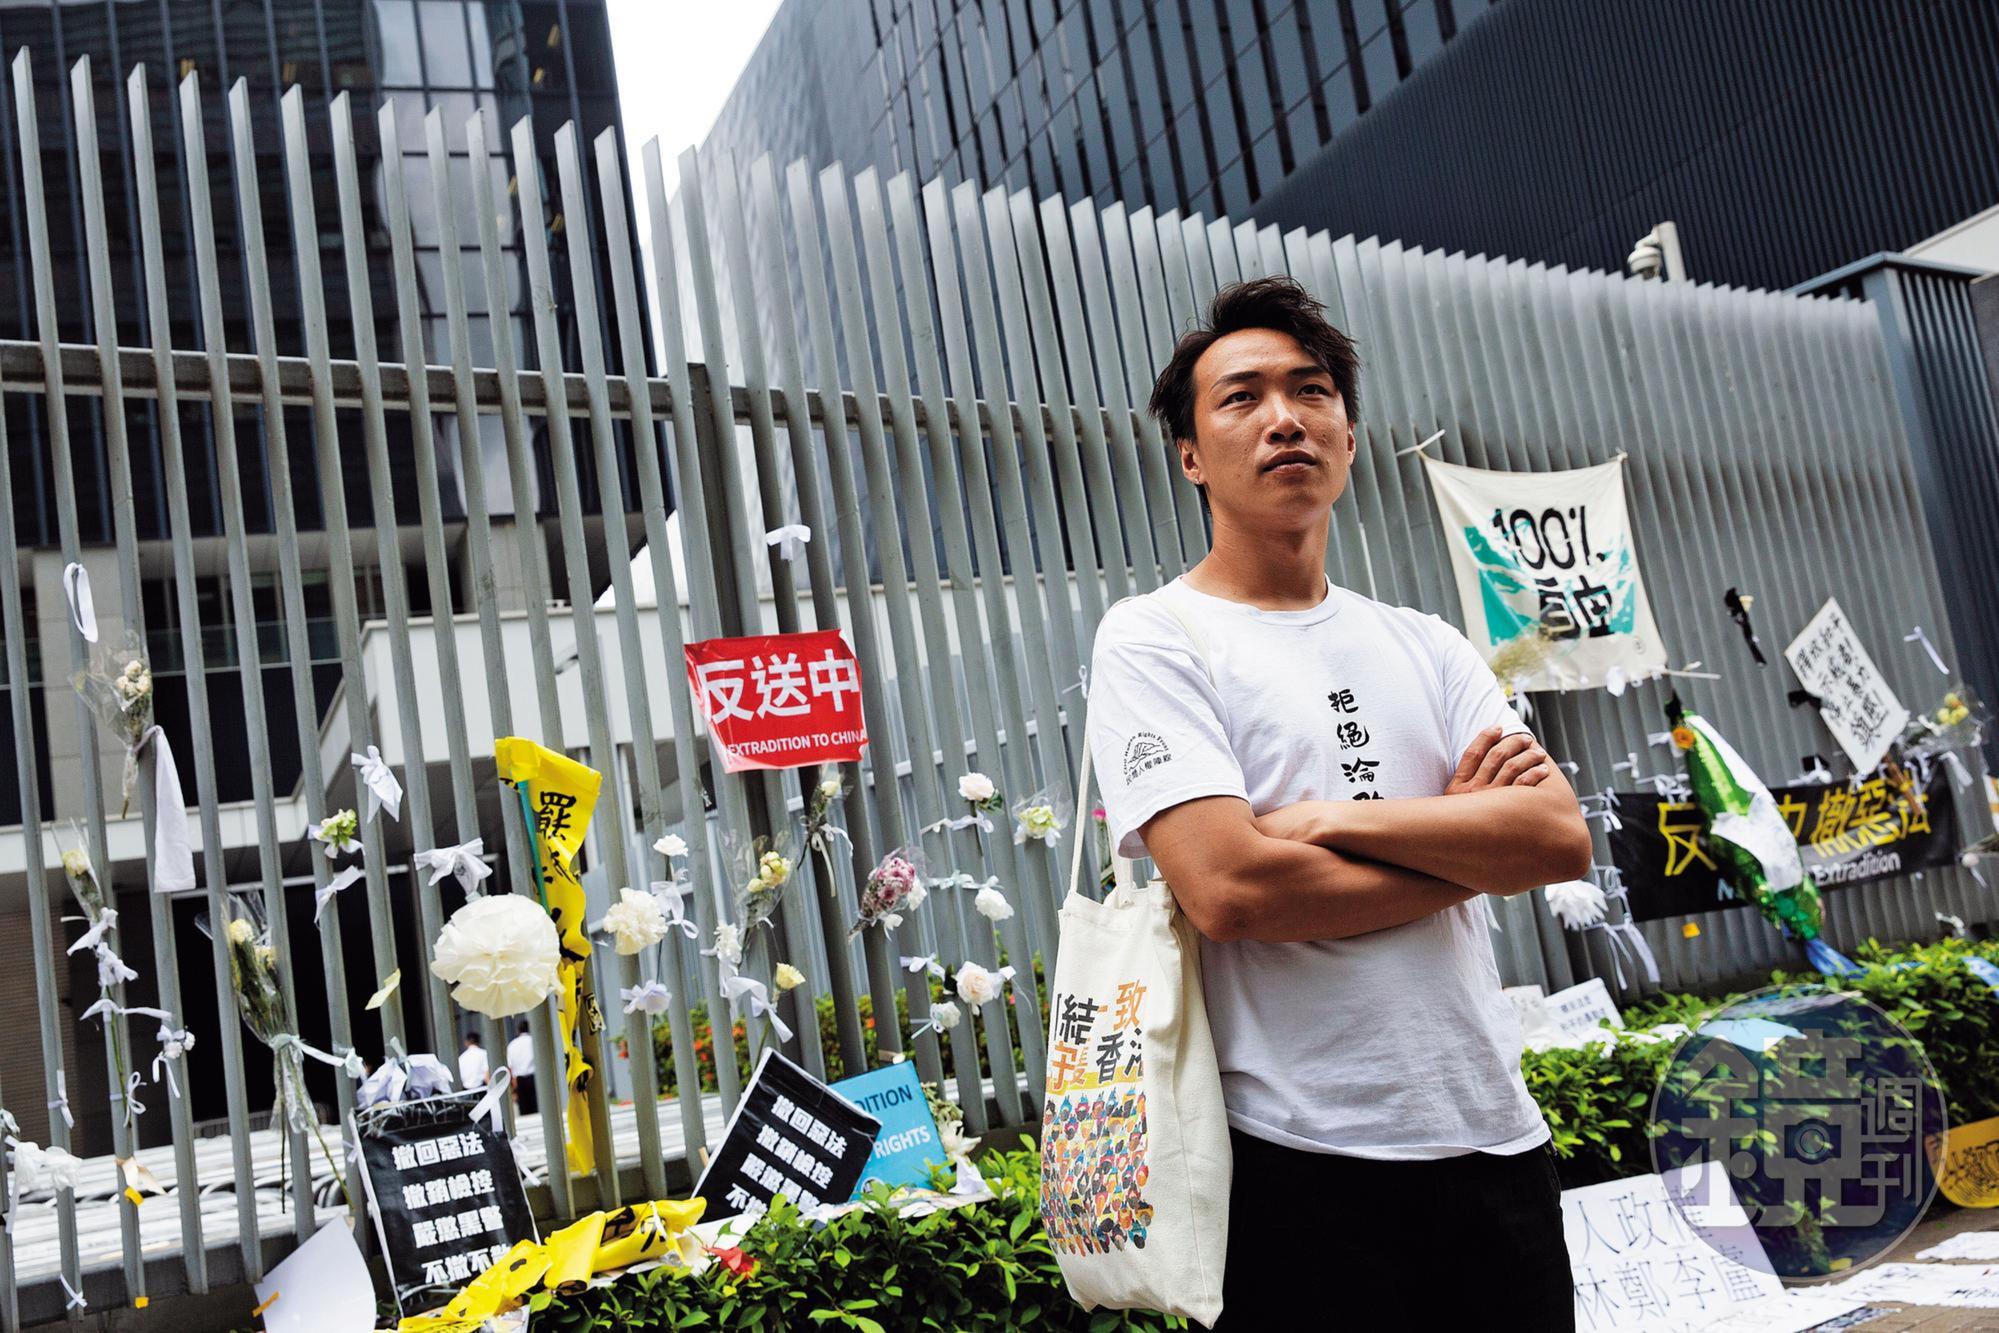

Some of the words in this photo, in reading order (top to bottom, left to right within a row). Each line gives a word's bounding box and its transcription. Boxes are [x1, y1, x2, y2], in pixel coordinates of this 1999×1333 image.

[1492, 505, 1606, 570] 100%
[1534, 574, 1615, 640] 自由
[696, 648, 860, 725] 反送中
[726, 735, 811, 757] EXTRADITION
[811, 732, 830, 748] TO
[831, 727, 868, 745] CHINA
[539, 790, 577, 841] 罷
[1054, 979, 1147, 1046] 結一致
[391, 1130, 486, 1171] 撤回惡法
[771, 1094, 848, 1160] 撤回惡法
[872, 1124, 932, 1160] RIGHTS
[402, 1168, 496, 1210] 撤銷檢控
